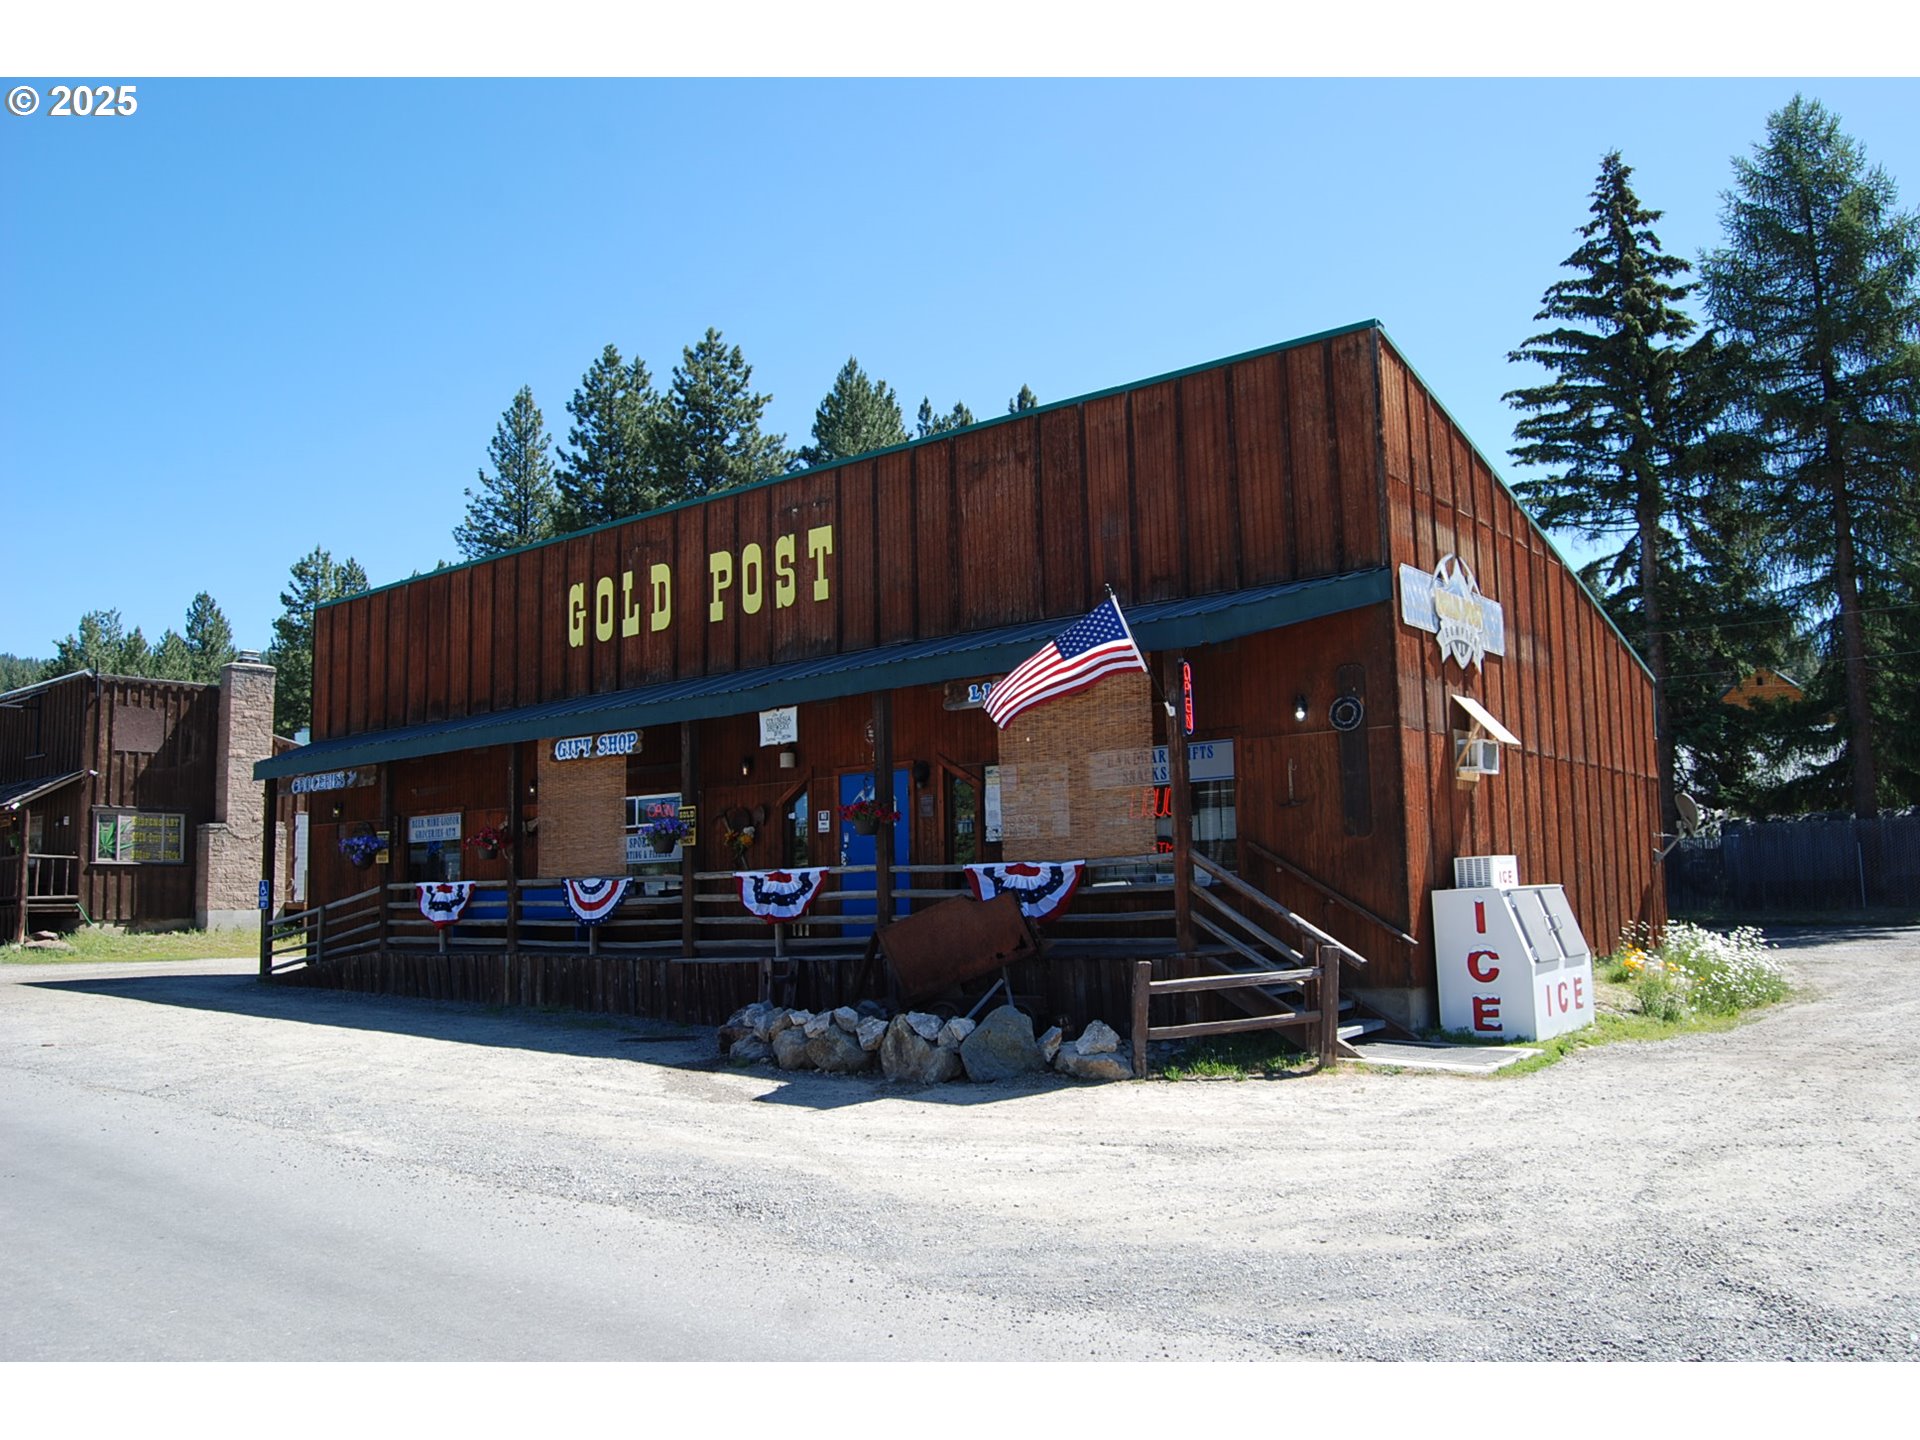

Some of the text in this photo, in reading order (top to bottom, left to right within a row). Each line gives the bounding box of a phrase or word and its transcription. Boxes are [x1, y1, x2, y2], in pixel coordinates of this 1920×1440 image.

[568, 525, 833, 647] GOLD POST
[1183, 663, 1193, 730] OPEN
[555, 731, 638, 761] GIFT SHOP
[291, 771, 345, 794] GROCERIES
[629, 836, 648, 849] SPOR
[1498, 869, 1514, 885] ICE
[1466, 894, 1504, 1032] ICE
[1546, 975, 1585, 1018] ICE
